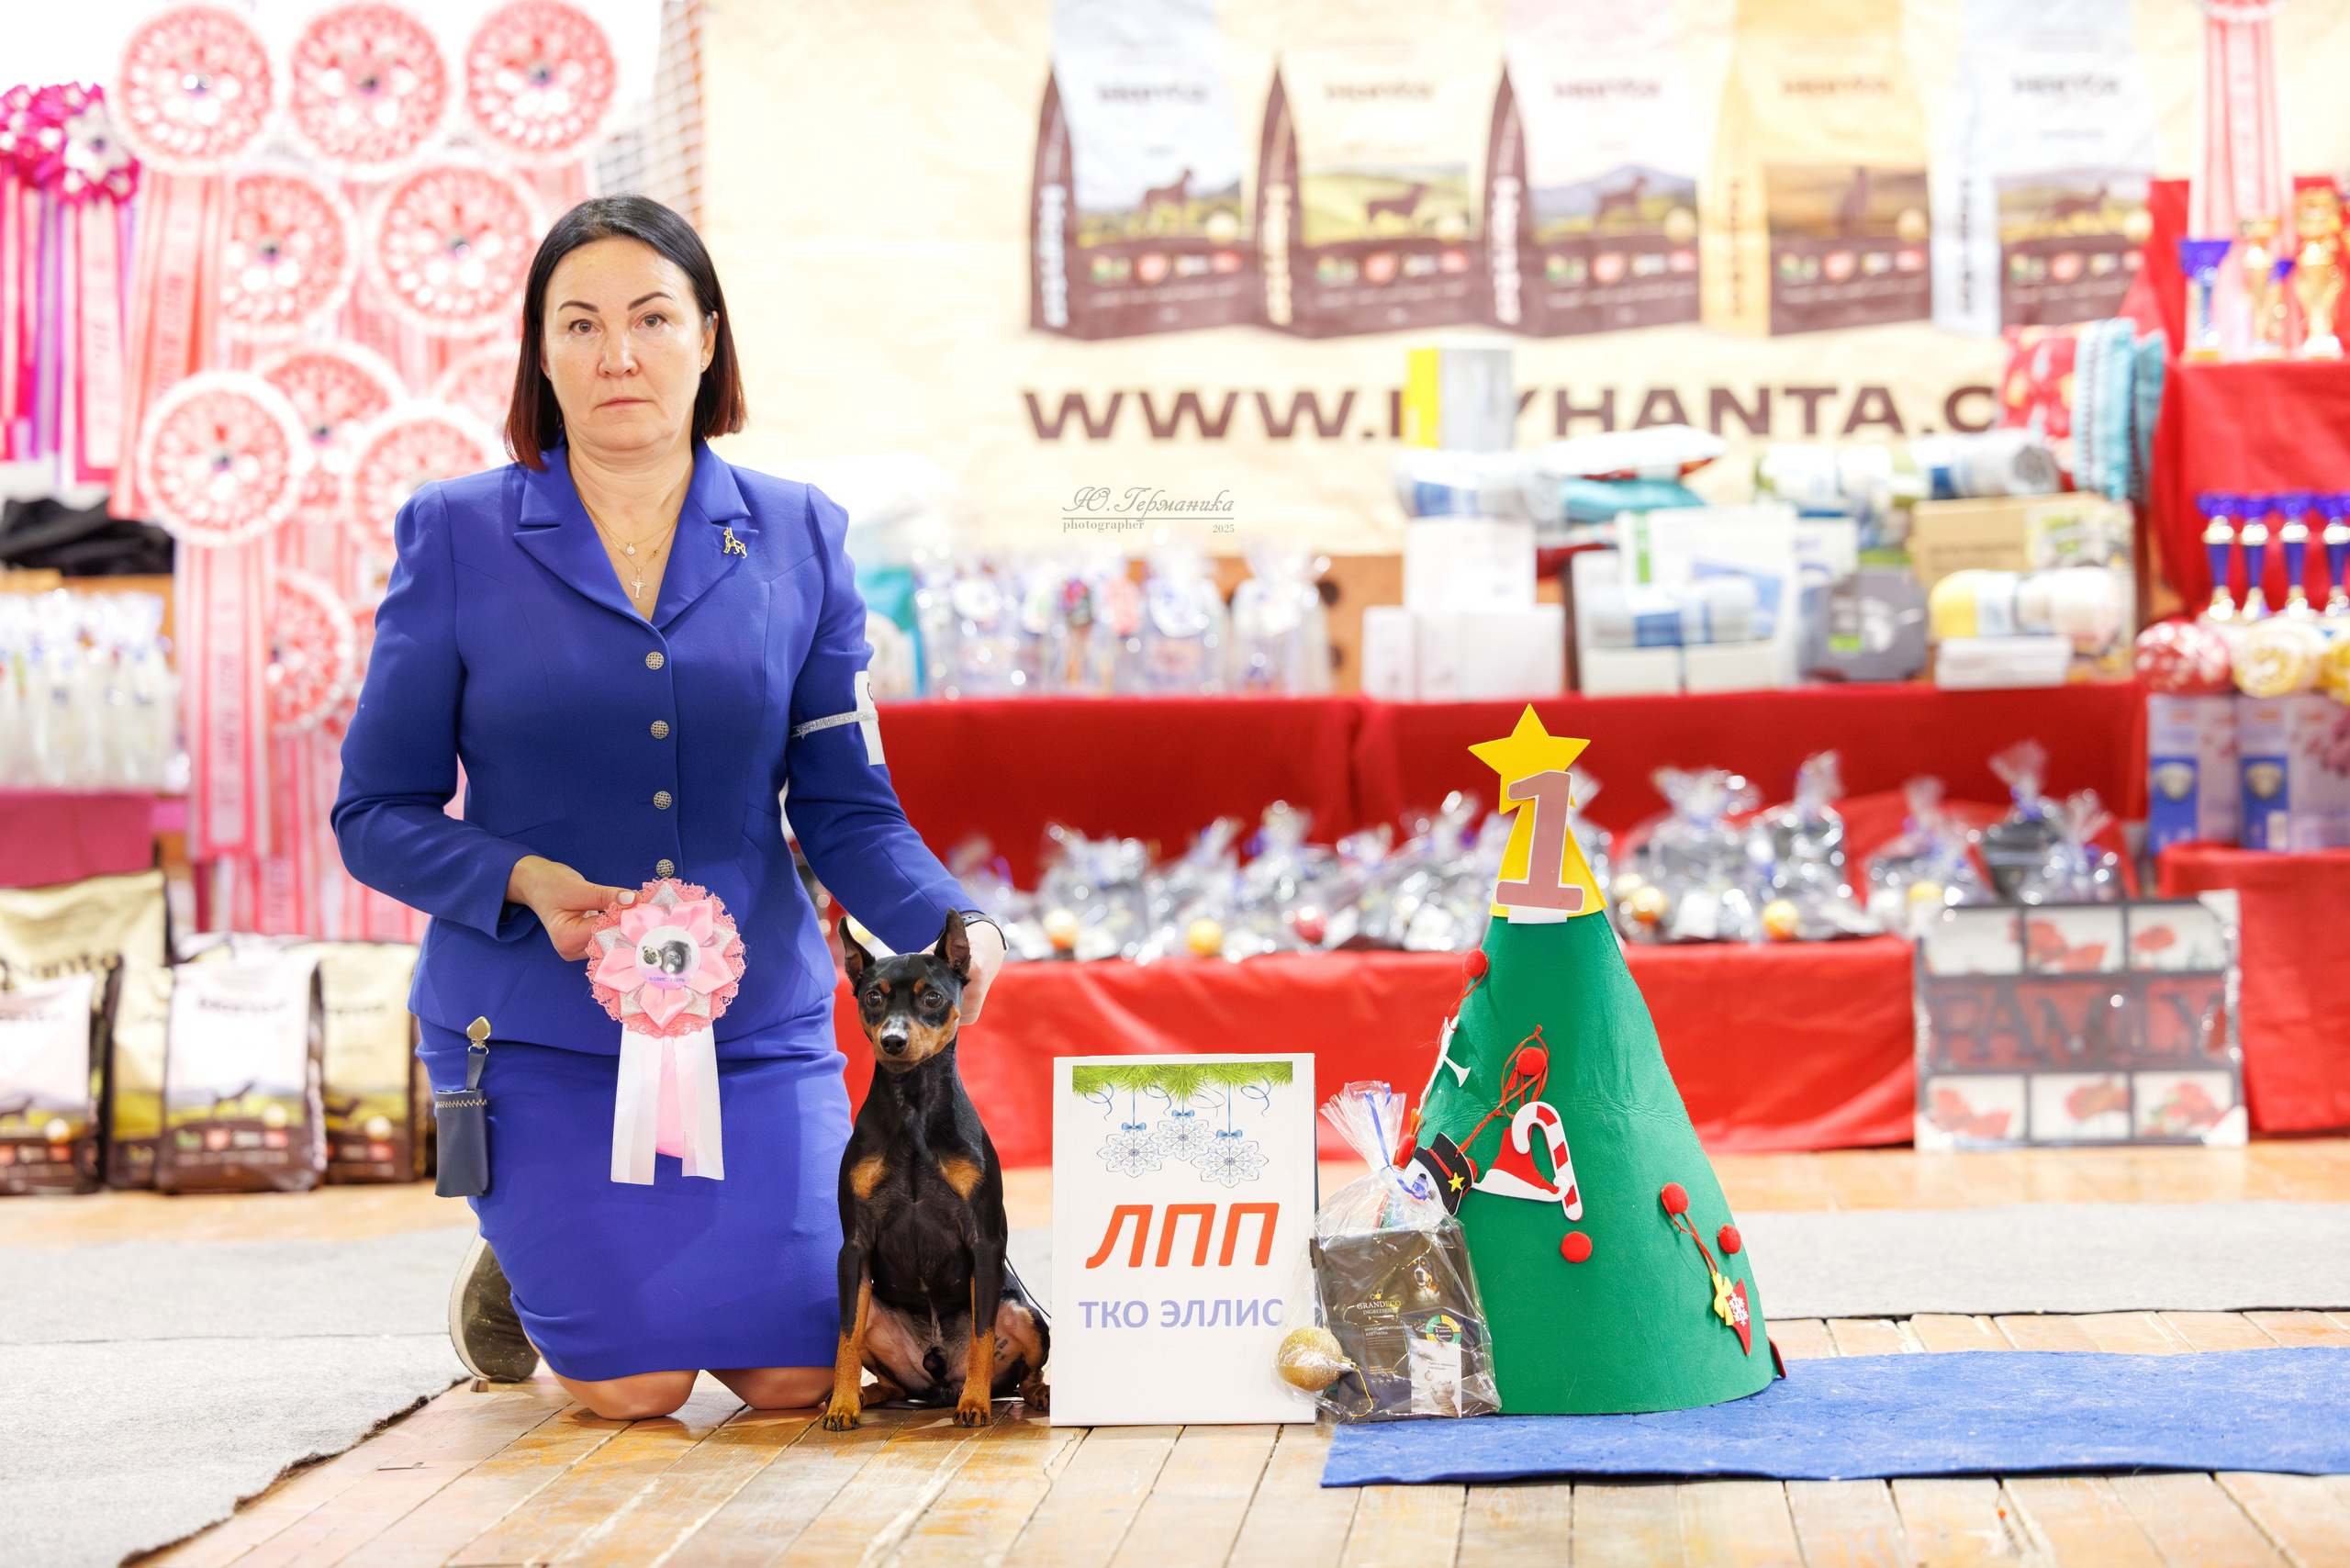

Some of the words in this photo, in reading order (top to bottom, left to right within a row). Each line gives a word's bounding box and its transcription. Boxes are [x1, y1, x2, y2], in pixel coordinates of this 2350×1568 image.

[1494, 769, 1584, 913] 1
[1085, 1203, 1280, 1270] ЛПП
[1079, 1300, 1149, 1328] ТКО
[1160, 1299, 1283, 1327] ЭЛЛИС
[1357, 1300, 1402, 1310] GRANDECO
